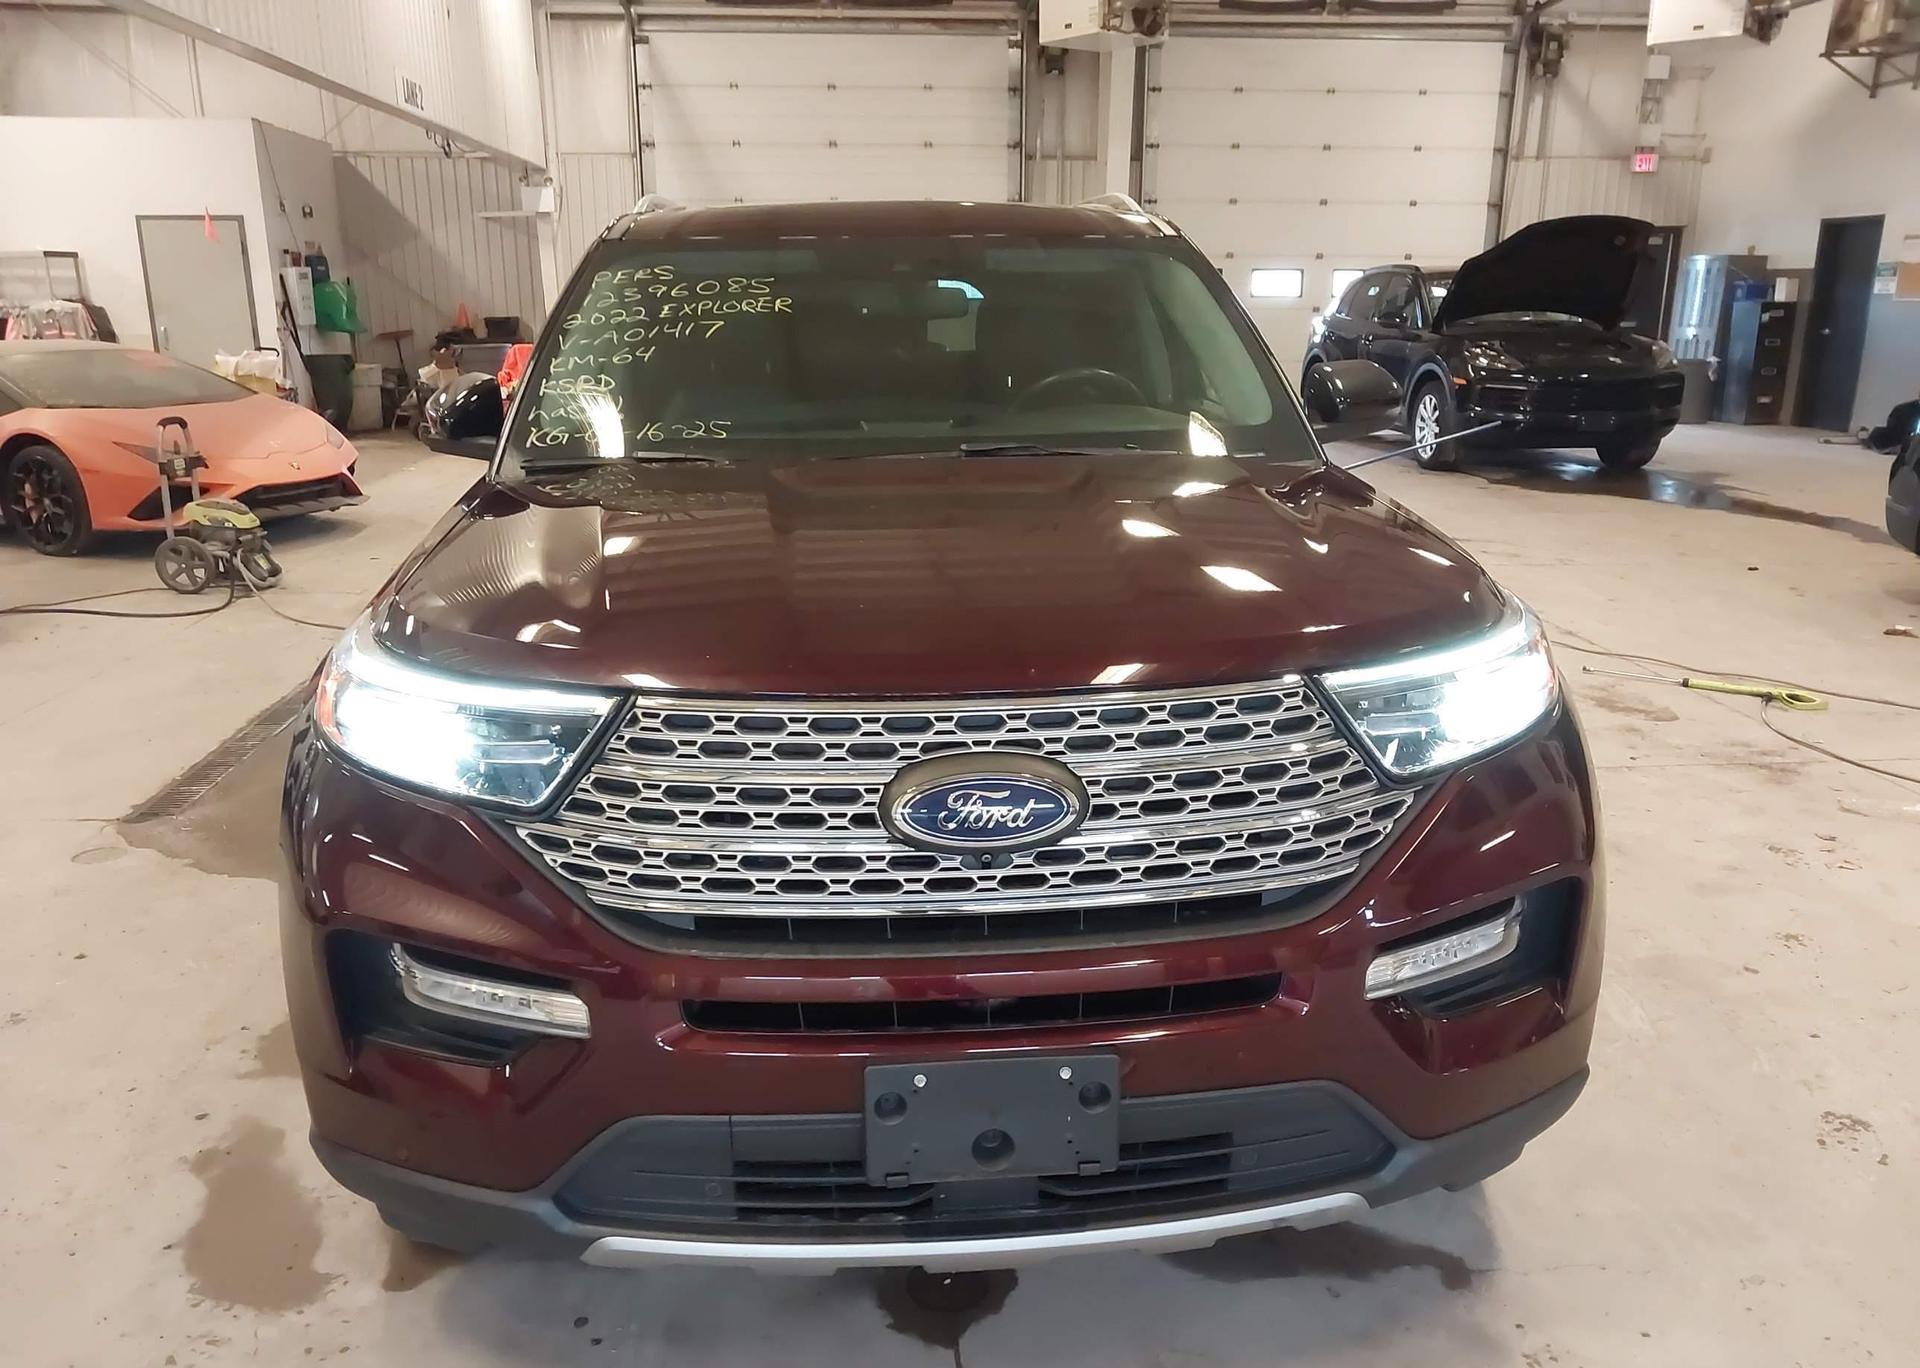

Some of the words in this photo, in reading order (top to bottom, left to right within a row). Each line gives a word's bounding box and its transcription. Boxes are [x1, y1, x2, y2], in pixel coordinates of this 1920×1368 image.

[592, 265, 675, 289] PERS
[562, 306, 650, 329] 2022
[659, 296, 793, 319] EXPLORER
[550, 346, 656, 375] KM-64
[937, 789, 1056, 831] Ford
